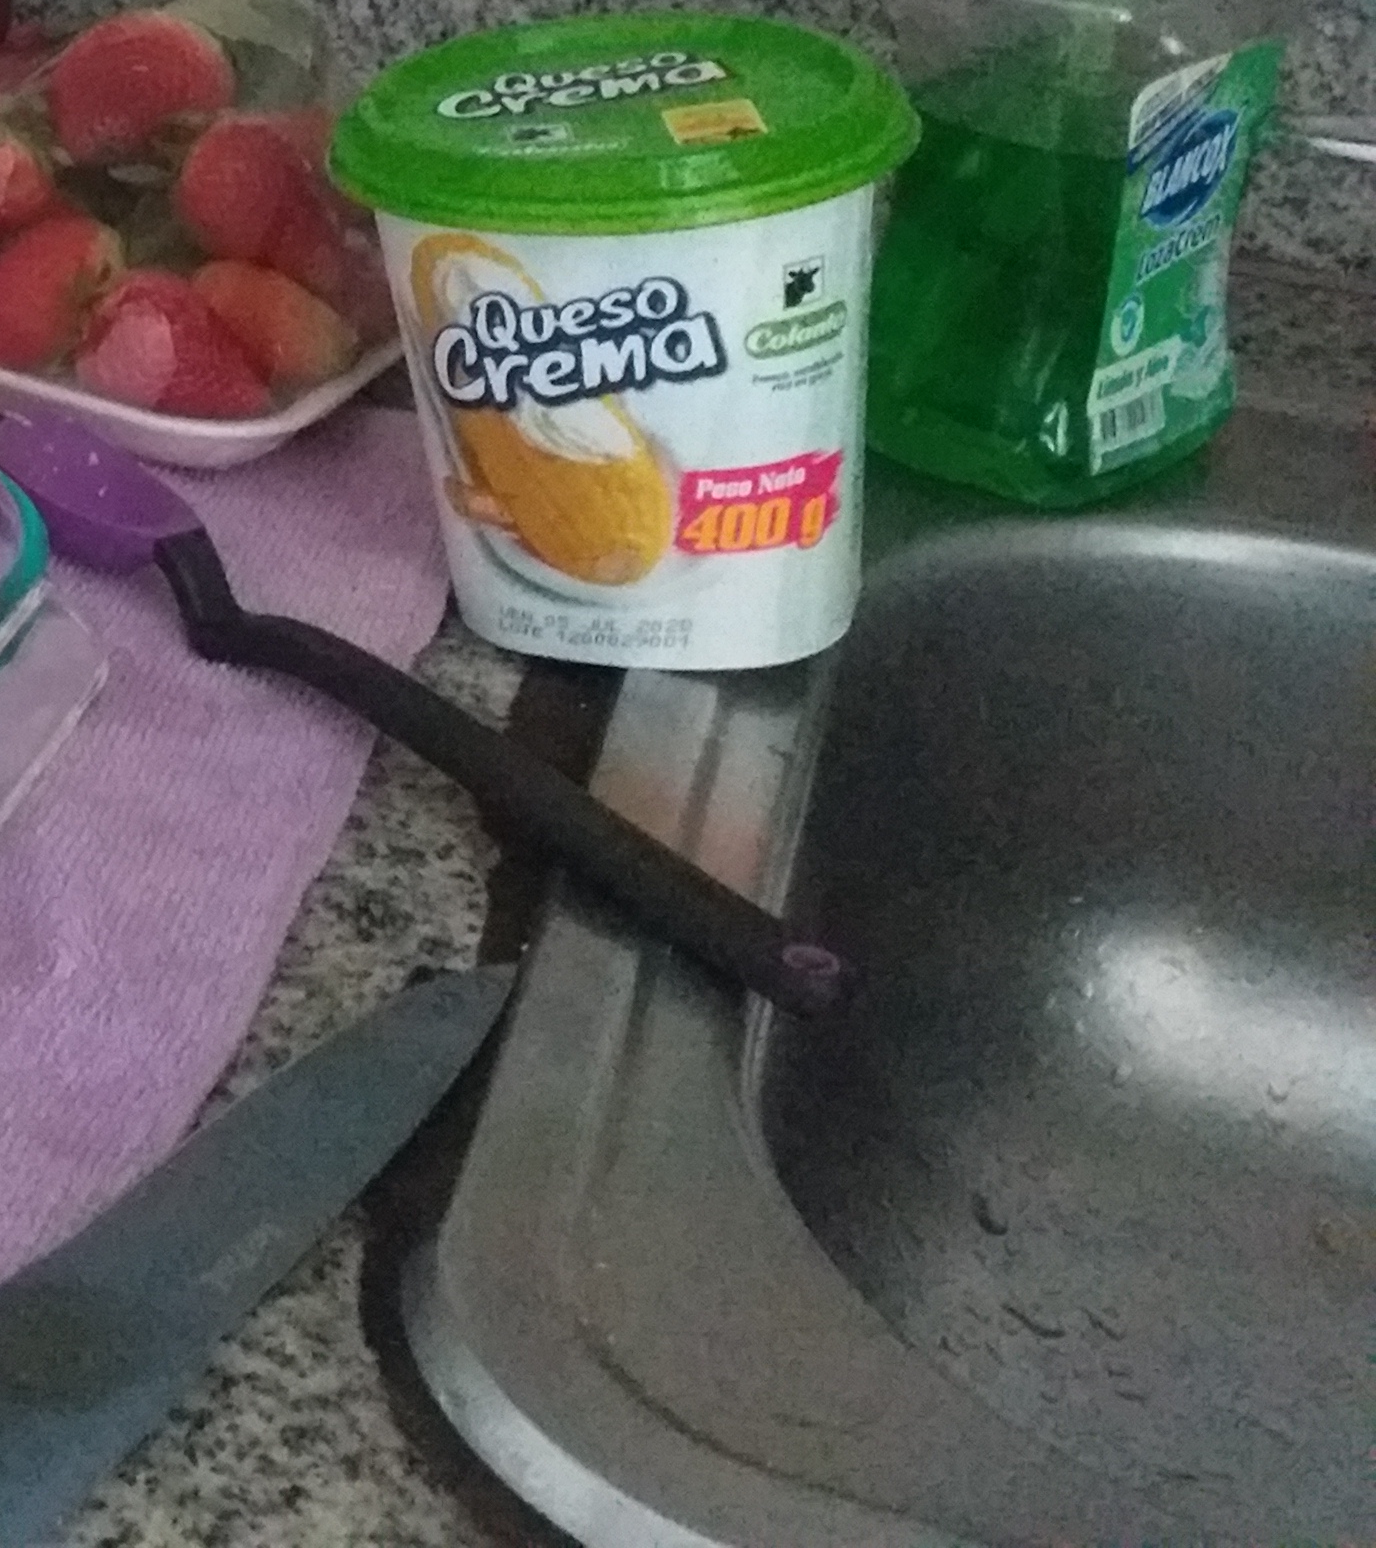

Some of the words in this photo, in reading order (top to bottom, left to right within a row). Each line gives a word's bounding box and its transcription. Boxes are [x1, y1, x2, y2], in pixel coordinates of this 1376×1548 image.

[436, 60, 728, 119] Crema
[494, 51, 688, 94] Queso
[472, 278, 681, 353] Queso
[434, 317, 719, 403] Crema
[695, 478, 753, 500] Peso
[757, 465, 806, 495] Neto
[681, 495, 793, 551] 400
[800, 493, 828, 547] g
